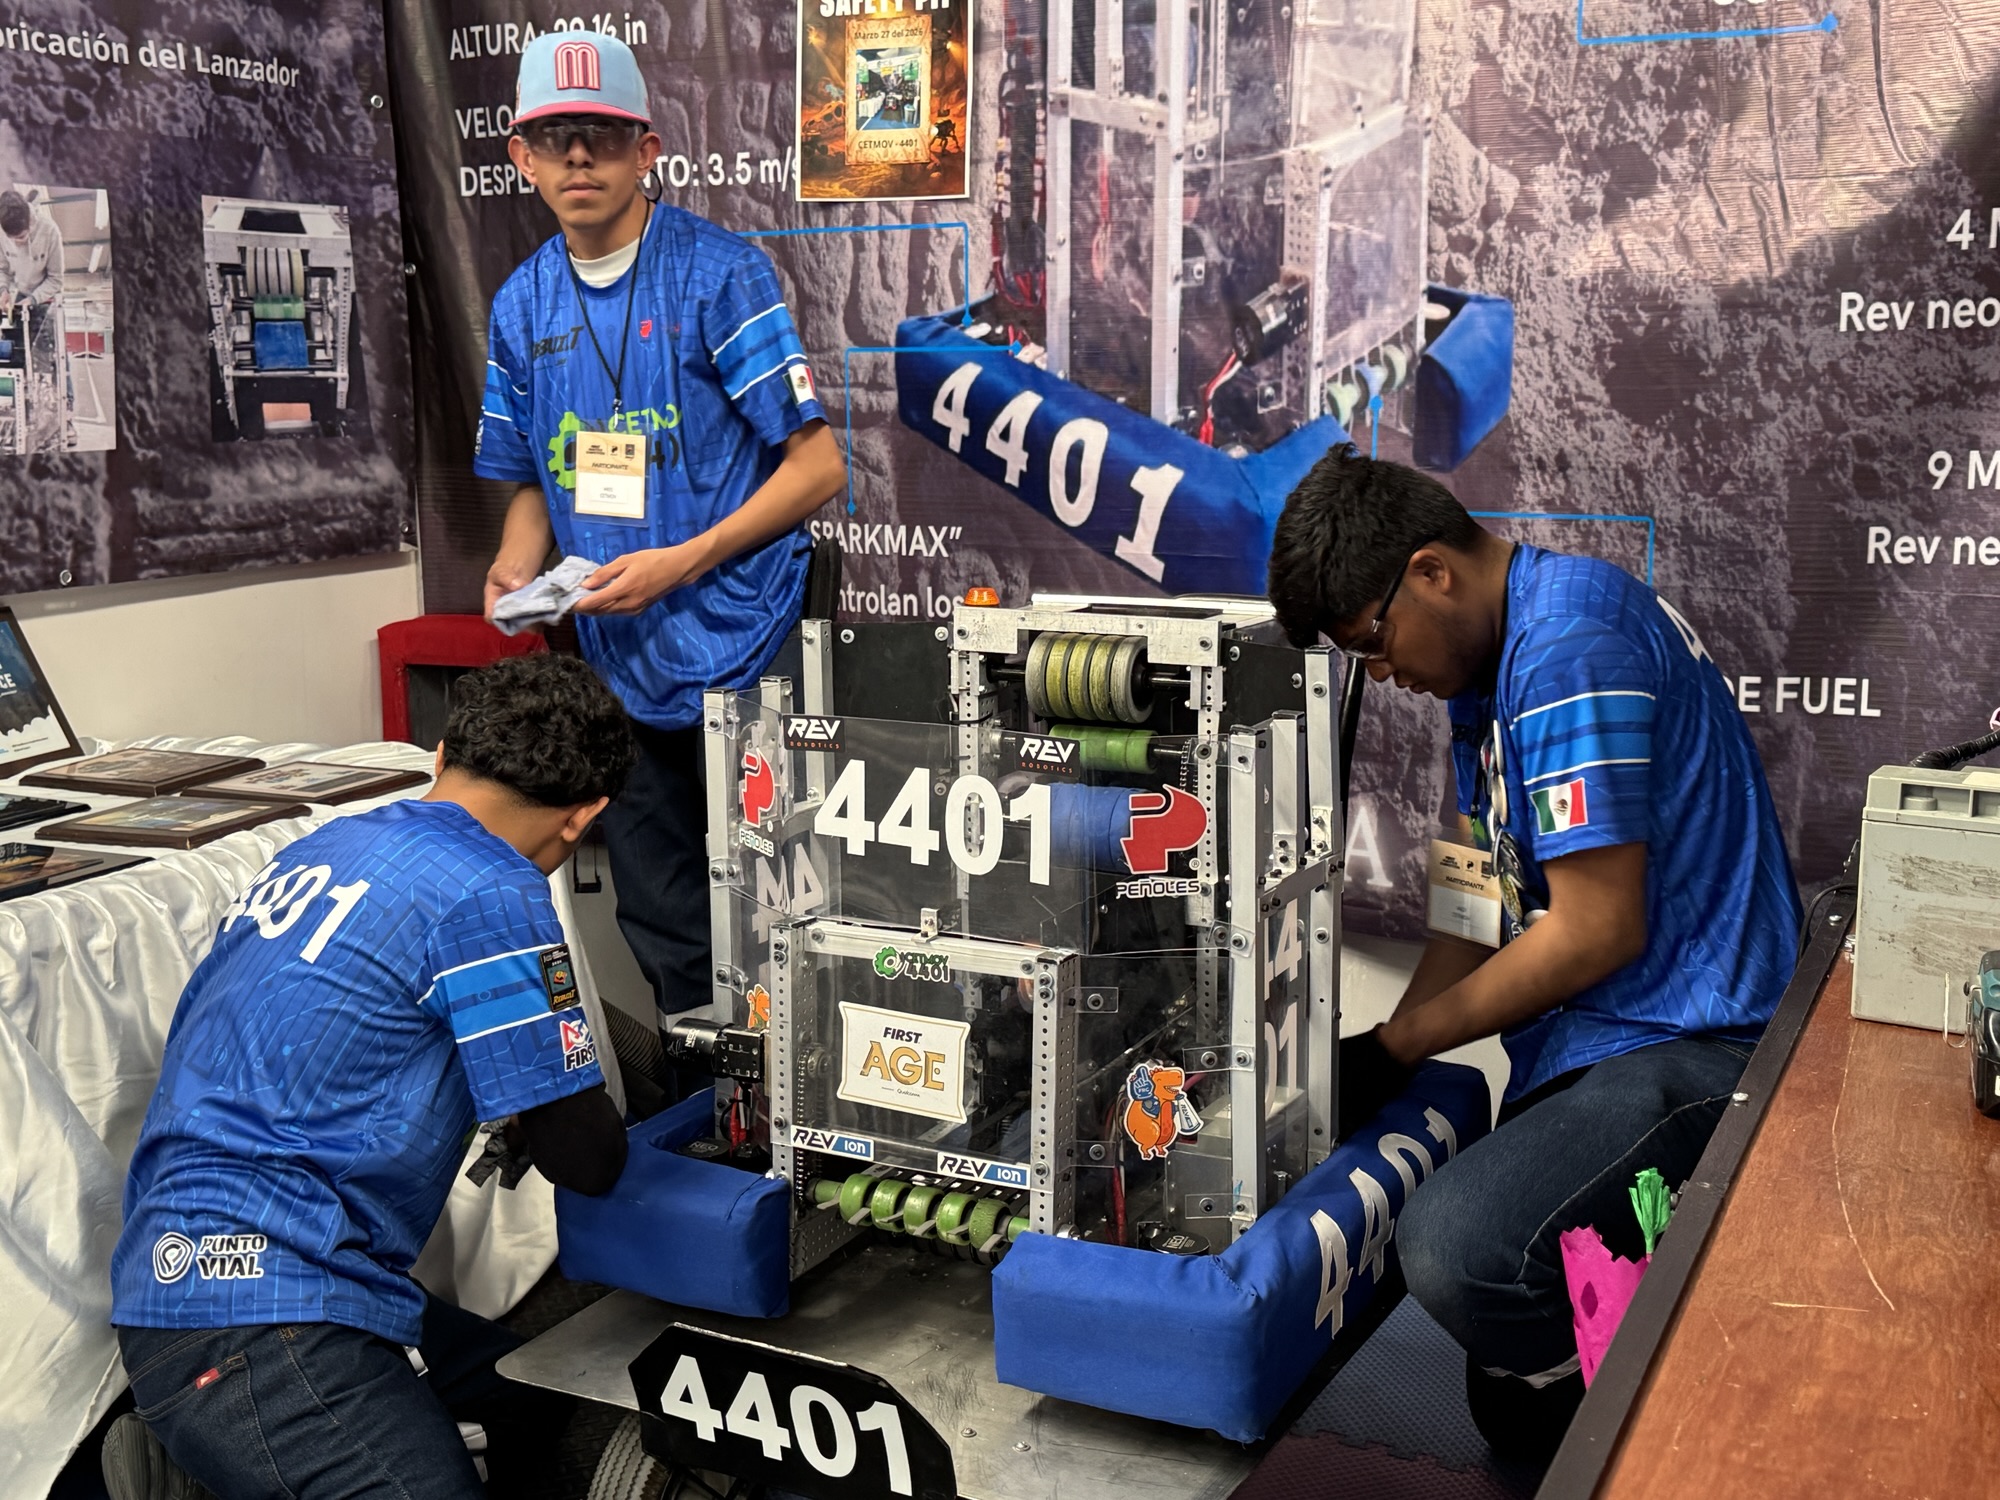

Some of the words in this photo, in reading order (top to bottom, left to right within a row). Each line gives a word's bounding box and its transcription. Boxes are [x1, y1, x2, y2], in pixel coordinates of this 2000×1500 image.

[624, 12, 648, 46] in
[854, 30, 880, 41] Marzo
[881, 30, 890, 39] 27
[891, 29, 904, 39] del
[0, 22, 130, 65] ricación
[138, 40, 187, 71] del
[194, 46, 300, 88] Lanzador
[455, 104, 514, 140] VELO
[858, 140, 894, 149] CETMOV
[899, 138, 919, 149] 4401
[707, 151, 752, 187] 3.5
[1946, 209, 1975, 251] 4
[1839, 291, 1915, 333] Rev
[1926, 296, 2000, 330] neo
[931, 361, 1185, 584] 4401
[1927, 450, 1953, 490] 9
[1867, 525, 1941, 565] Rev
[837, 582, 919, 617] ntrolan
[1723, 675, 1762, 713] E
[1776, 677, 1881, 718] FUEL
[787, 718, 842, 741] REV
[789, 740, 841, 750] ROBOTICS
[1019, 737, 1076, 763] REV
[1021, 761, 1074, 774] ROBOTICS
[814, 758, 1051, 886] 4401
[906, 962, 950, 982] 4401
[883, 1026, 923, 1044] FIRST
[860, 1040, 946, 1092] AGE
[792, 1128, 836, 1151] REV
[939, 1155, 988, 1179] REV
[200, 1235, 266, 1253] PUNTO
[197, 1255, 263, 1277] VIAL
[660, 1354, 913, 1497] 4401
